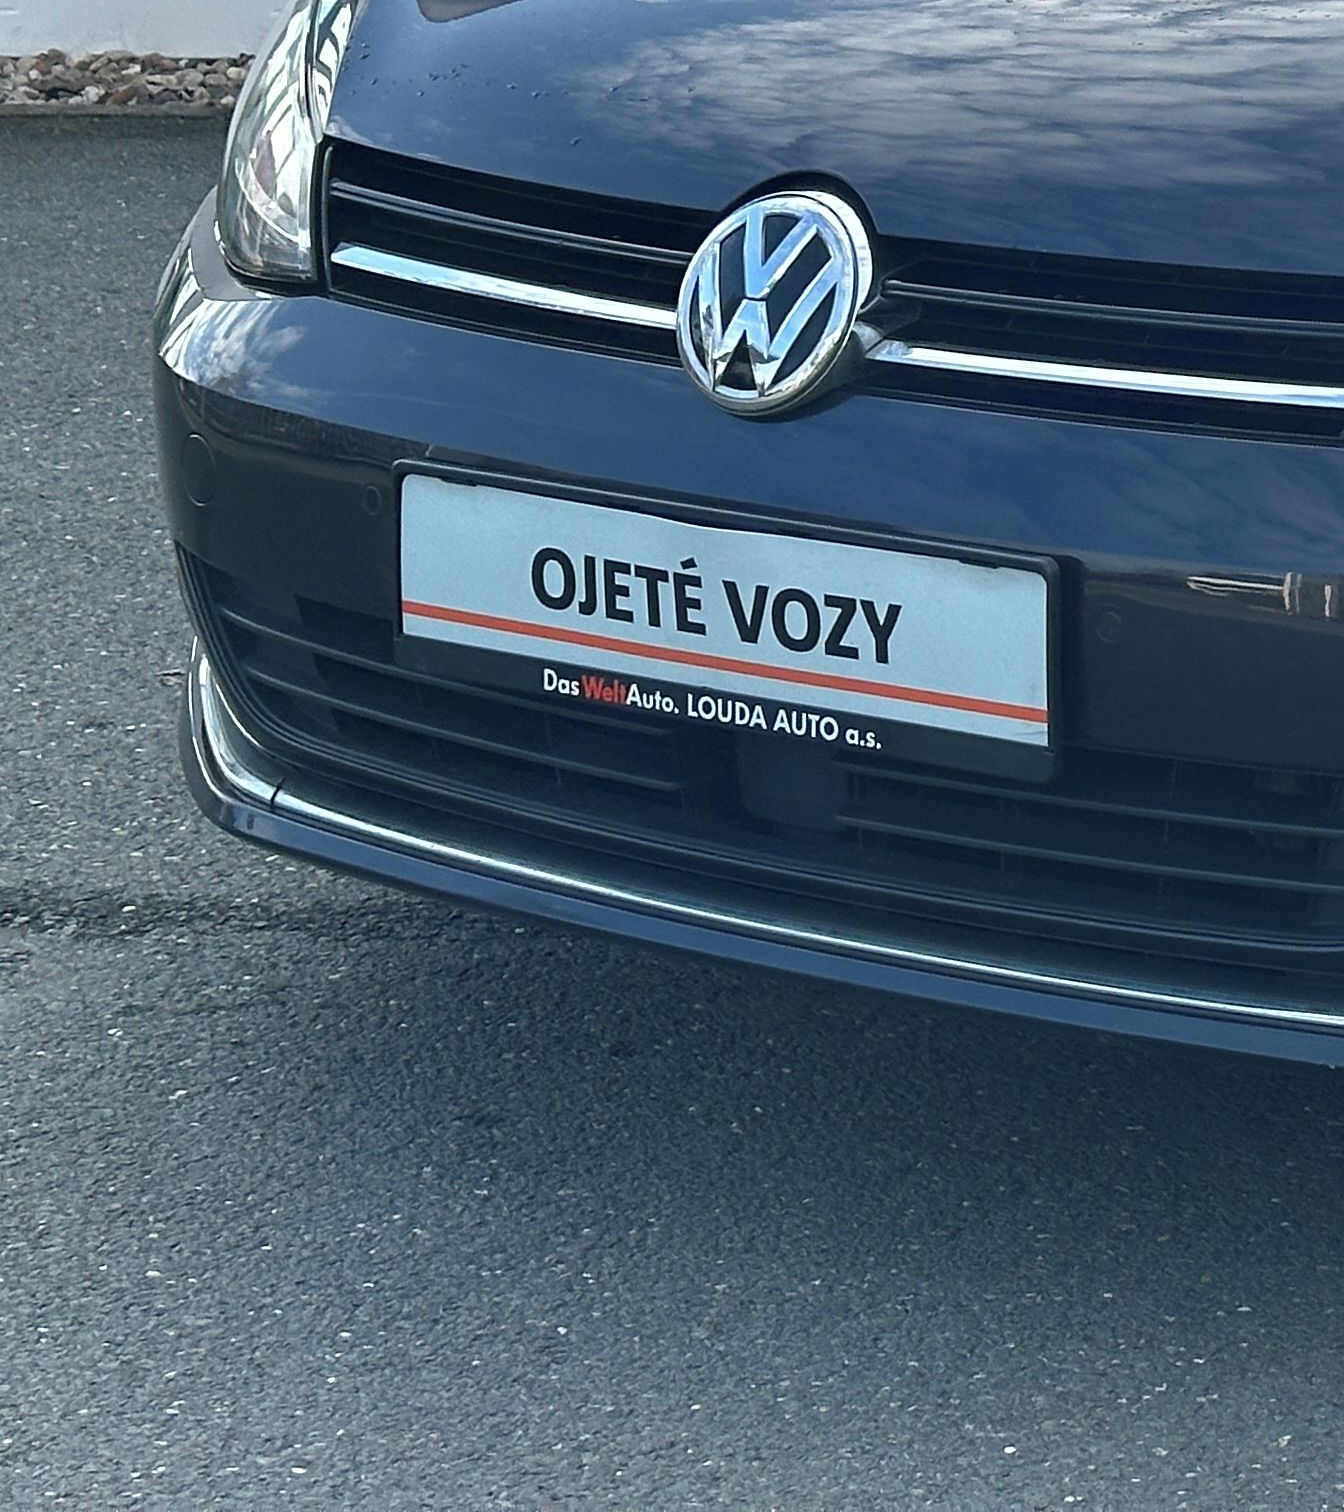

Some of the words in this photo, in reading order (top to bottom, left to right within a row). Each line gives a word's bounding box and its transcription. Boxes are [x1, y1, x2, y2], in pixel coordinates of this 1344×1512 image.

[531, 546, 707, 636] OJETÉ
[721, 579, 903, 664] VOZY
[687, 693, 768, 730] LOUDA
[772, 710, 839, 741] AUTO
[845, 727, 883, 750] a.s.
